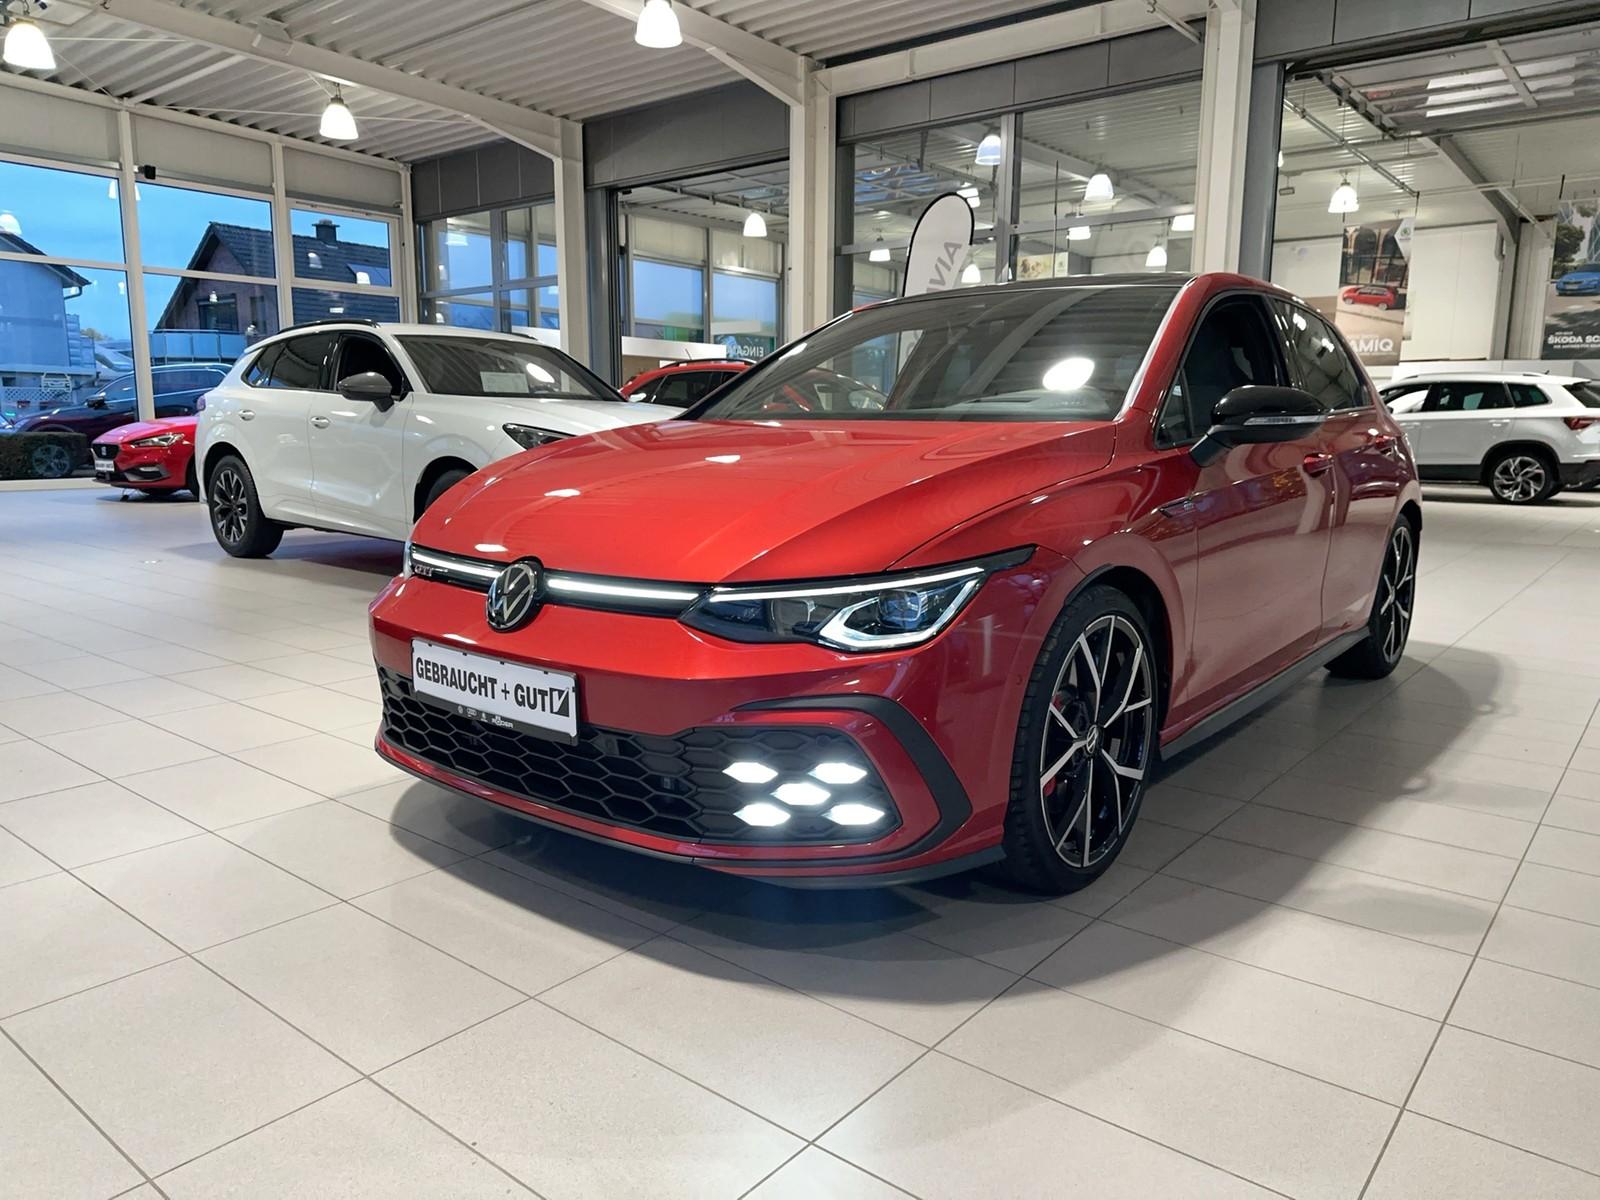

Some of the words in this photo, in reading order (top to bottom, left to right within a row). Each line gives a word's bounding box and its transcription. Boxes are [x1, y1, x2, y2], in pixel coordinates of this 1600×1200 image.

[1348, 338, 1393, 352] AMIQ
[1548, 334, 1583, 344] ŠKODA
[415, 656, 498, 700] GEBRAUCHT
[514, 683, 549, 713] GUT
